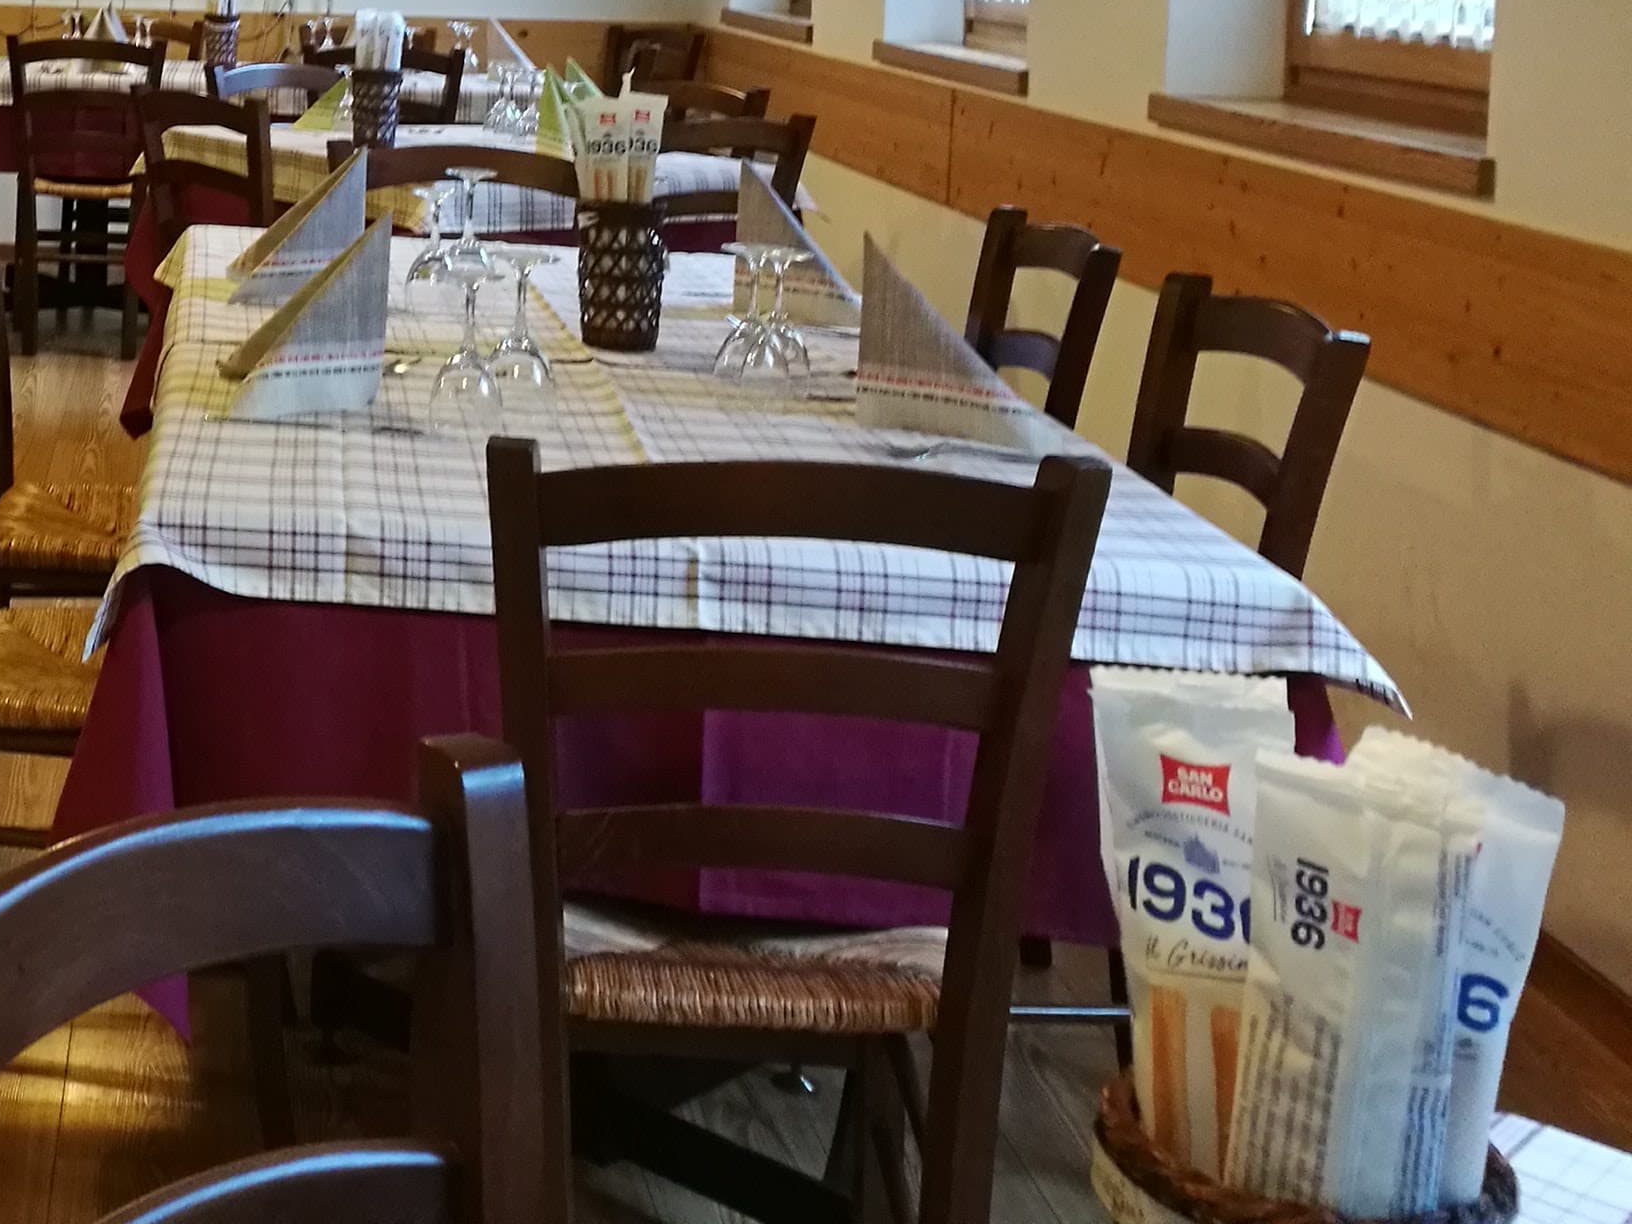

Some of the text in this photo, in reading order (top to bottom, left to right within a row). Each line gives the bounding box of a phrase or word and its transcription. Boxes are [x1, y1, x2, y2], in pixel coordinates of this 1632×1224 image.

[1177, 766, 1213, 786] SAN
[1168, 778, 1223, 803] CARLO
[1291, 857, 1329, 950] 1936
